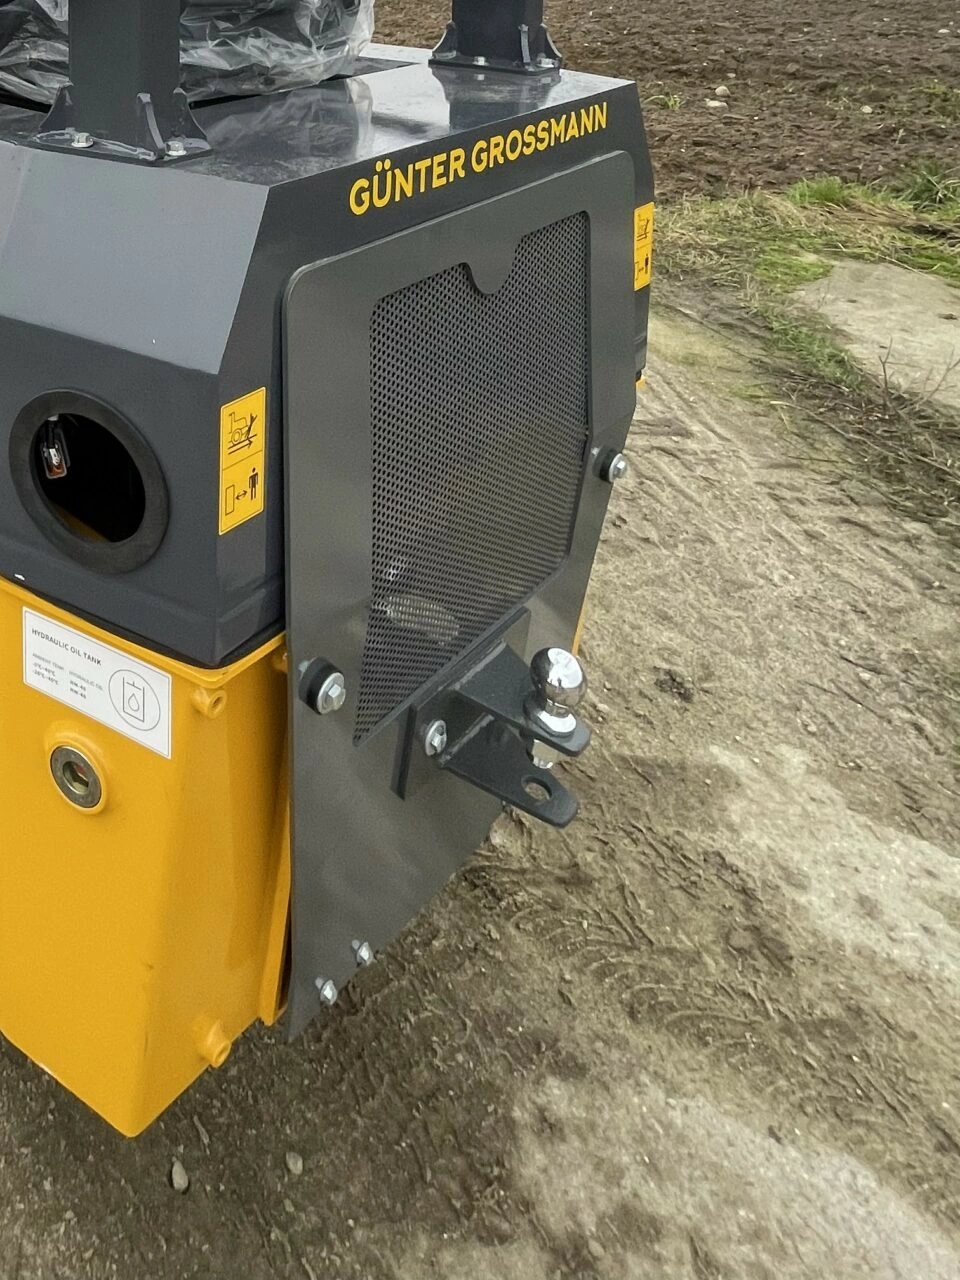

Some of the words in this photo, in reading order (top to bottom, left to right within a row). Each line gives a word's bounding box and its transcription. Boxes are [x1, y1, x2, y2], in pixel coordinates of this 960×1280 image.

[349, 147, 466, 216] GÜNTER
[471, 101, 608, 173] GROSSMANN
[31, 628, 69, 651] HYDRAULIC
[70, 646, 82, 657] OIL
[83, 651, 102, 666] TANK
